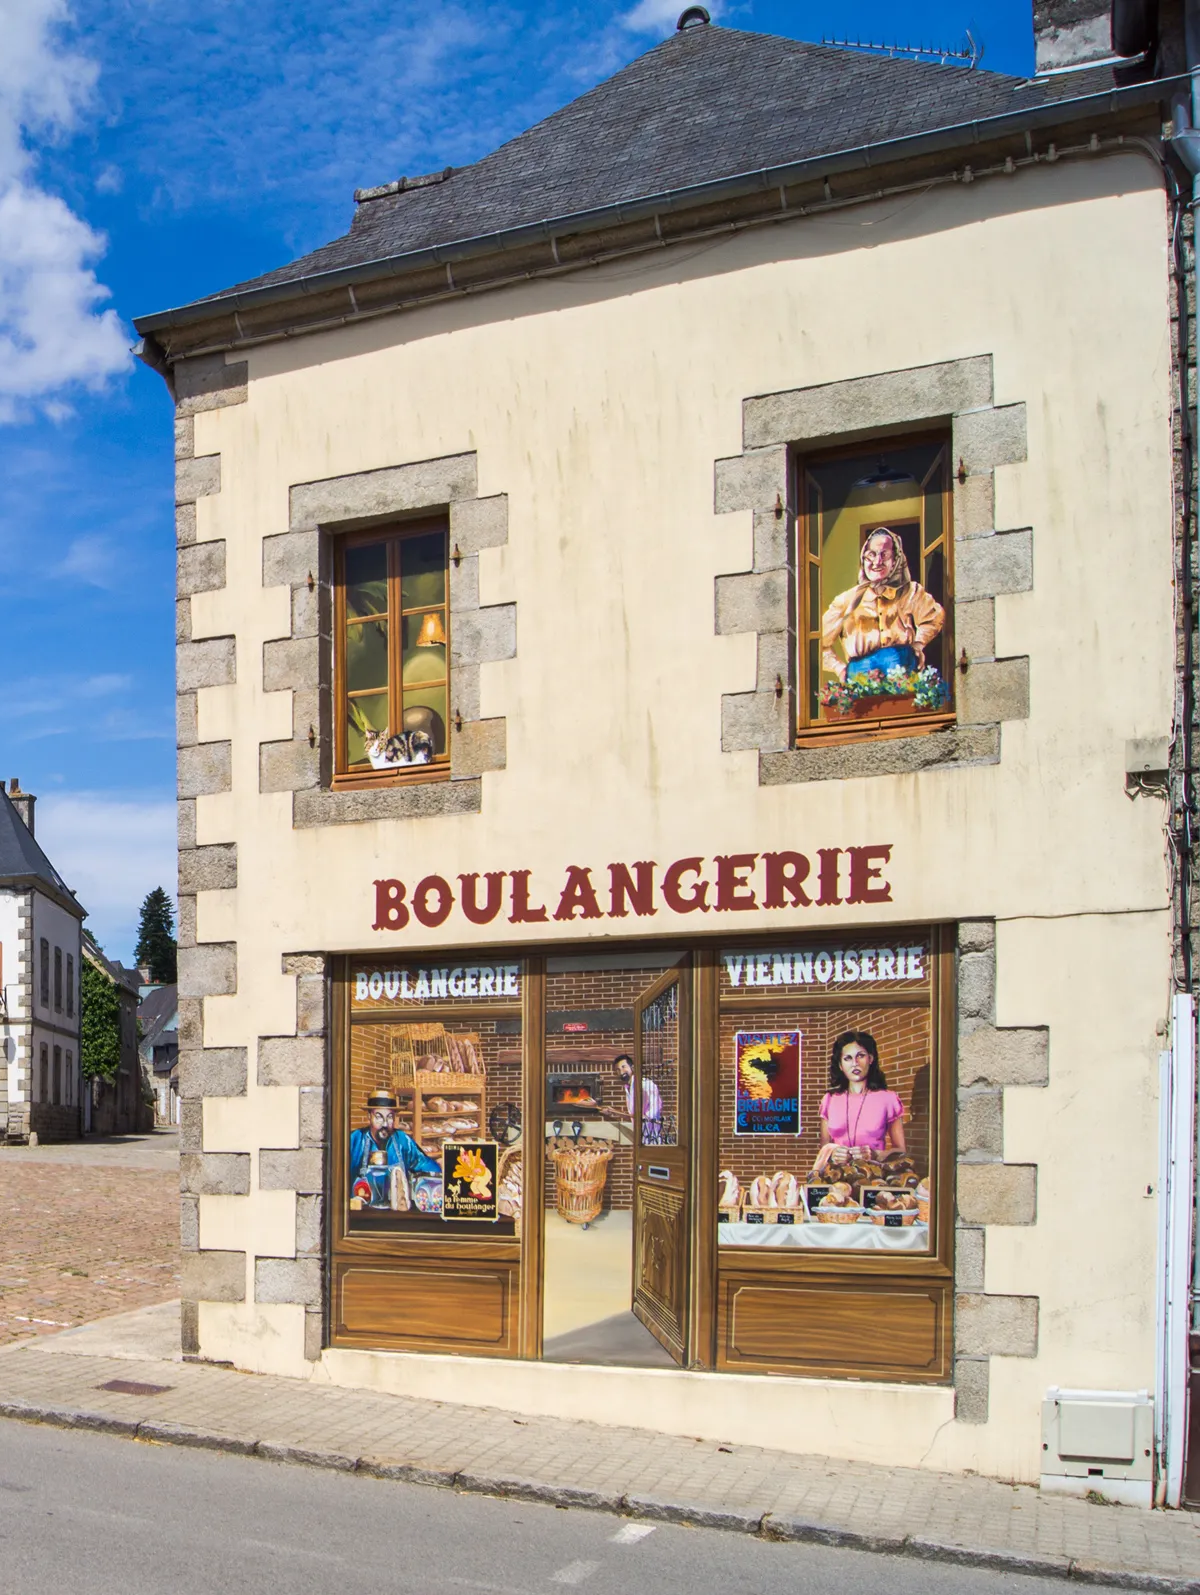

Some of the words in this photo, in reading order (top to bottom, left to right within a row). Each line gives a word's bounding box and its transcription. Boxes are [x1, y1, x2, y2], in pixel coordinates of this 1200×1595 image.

[371, 843, 894, 932] BOULANGERIE
[723, 946, 925, 987] VIENNOISERIE
[354, 965, 519, 1001] BOULANGERIE
[737, 1034, 797, 1045] VISITEZ
[737, 1098, 797, 1112] BRETAGNE
[456, 1203, 495, 1212] boulanger
